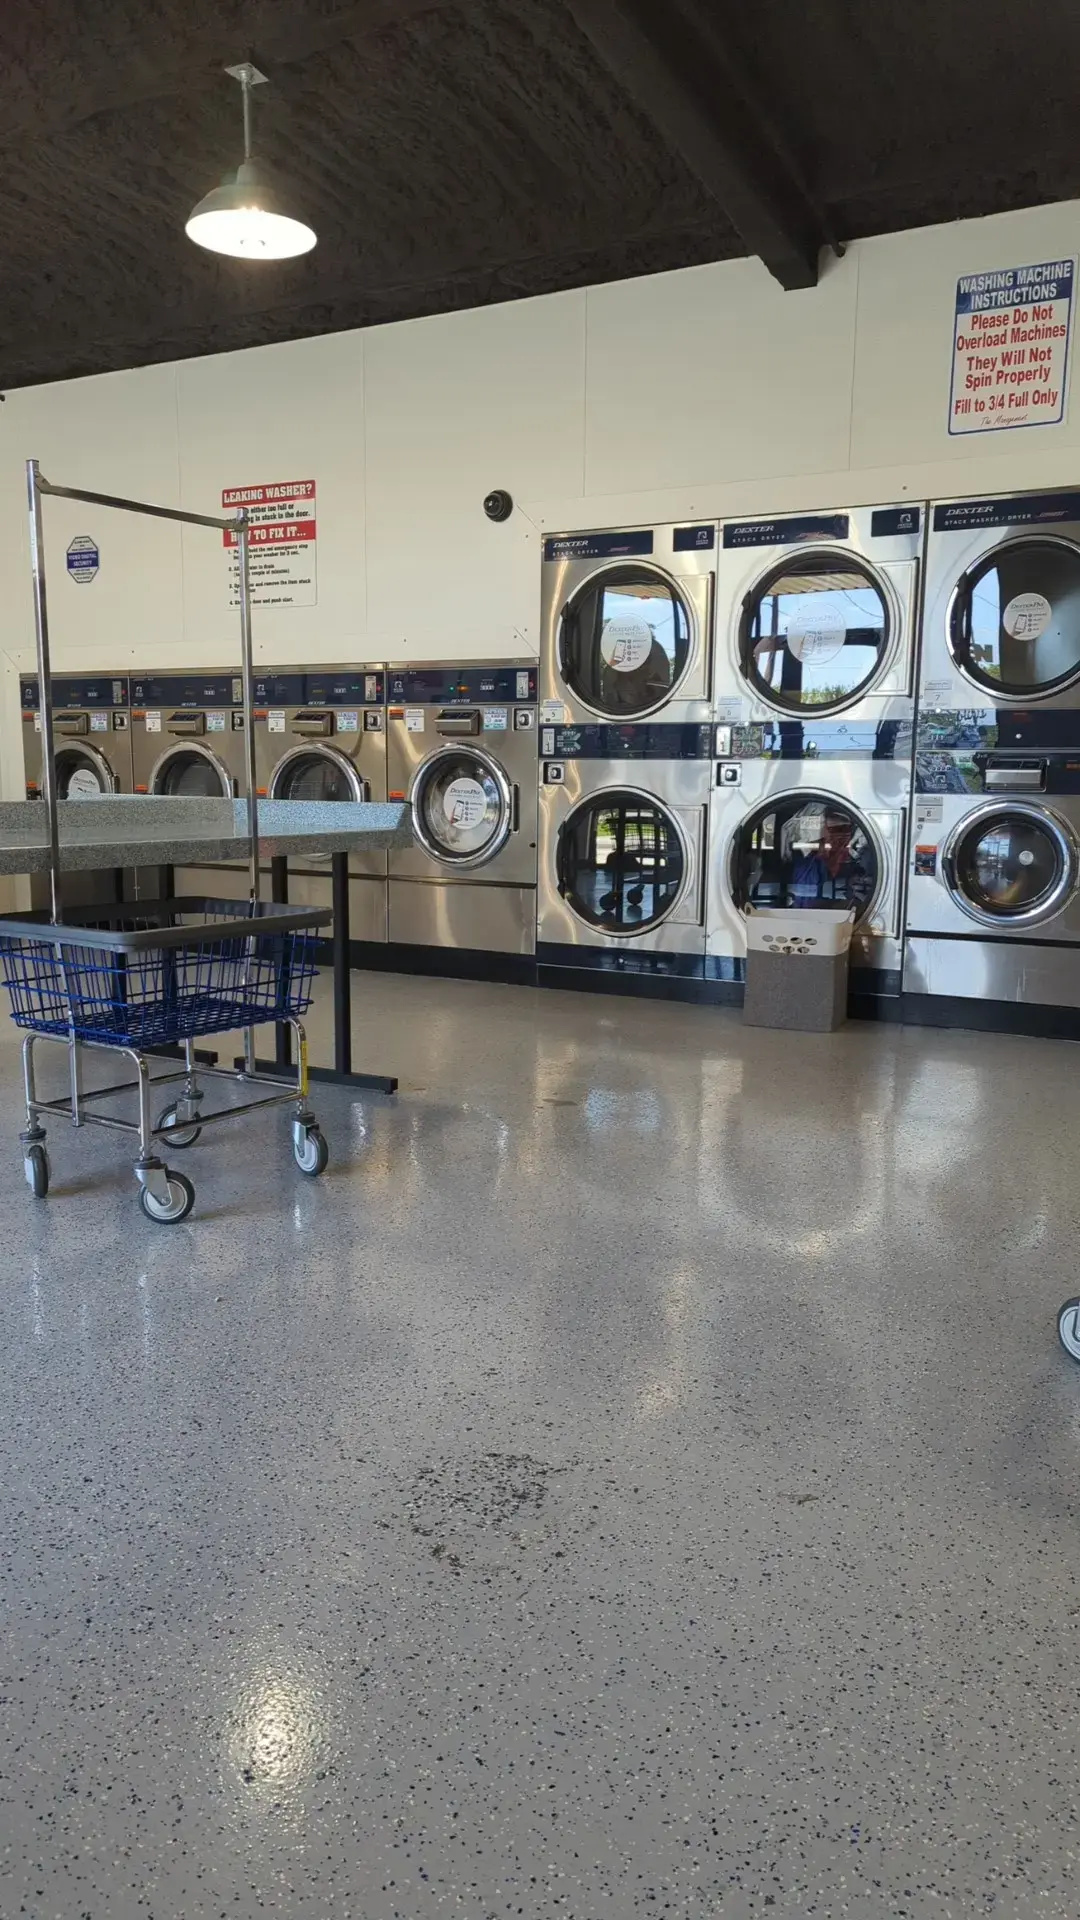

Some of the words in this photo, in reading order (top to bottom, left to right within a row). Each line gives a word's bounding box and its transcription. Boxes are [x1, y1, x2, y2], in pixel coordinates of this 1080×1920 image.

[960, 272, 1014, 294] WASHING
[1017, 262, 1071, 285] MACHINE
[970, 283, 1058, 310] INSTRUCTIONS
[970, 315, 1009, 331] Please
[1013, 308, 1028, 321] Do
[1032, 304, 1054, 319] Not
[956, 330, 1007, 351] Overload
[1010, 323, 1066, 344] Machines
[967, 355, 998, 372] They
[1001, 349, 1025, 366] Will
[1029, 347, 1052, 363] Not
[965, 373, 992, 392] Spin
[996, 365, 1051, 386] Properly
[954, 398, 971, 415] Fill
[974, 398, 985, 413] to
[988, 394, 1005, 411] 3/4
[1008, 391, 1028, 408] Full
[1032, 388, 1058, 408] Only
[224, 489, 263, 504] LEAKING
[266, 483, 312, 500] WASHER?
[250, 506, 266, 514] either
[945, 506, 994, 516] DEXTER
[254, 529, 267, 540] TO
[269, 528, 284, 539] FIX
[286, 526, 306, 537] IT...
[733, 525, 774, 534] DEXTER
[552, 540, 589, 548] DEXTER
